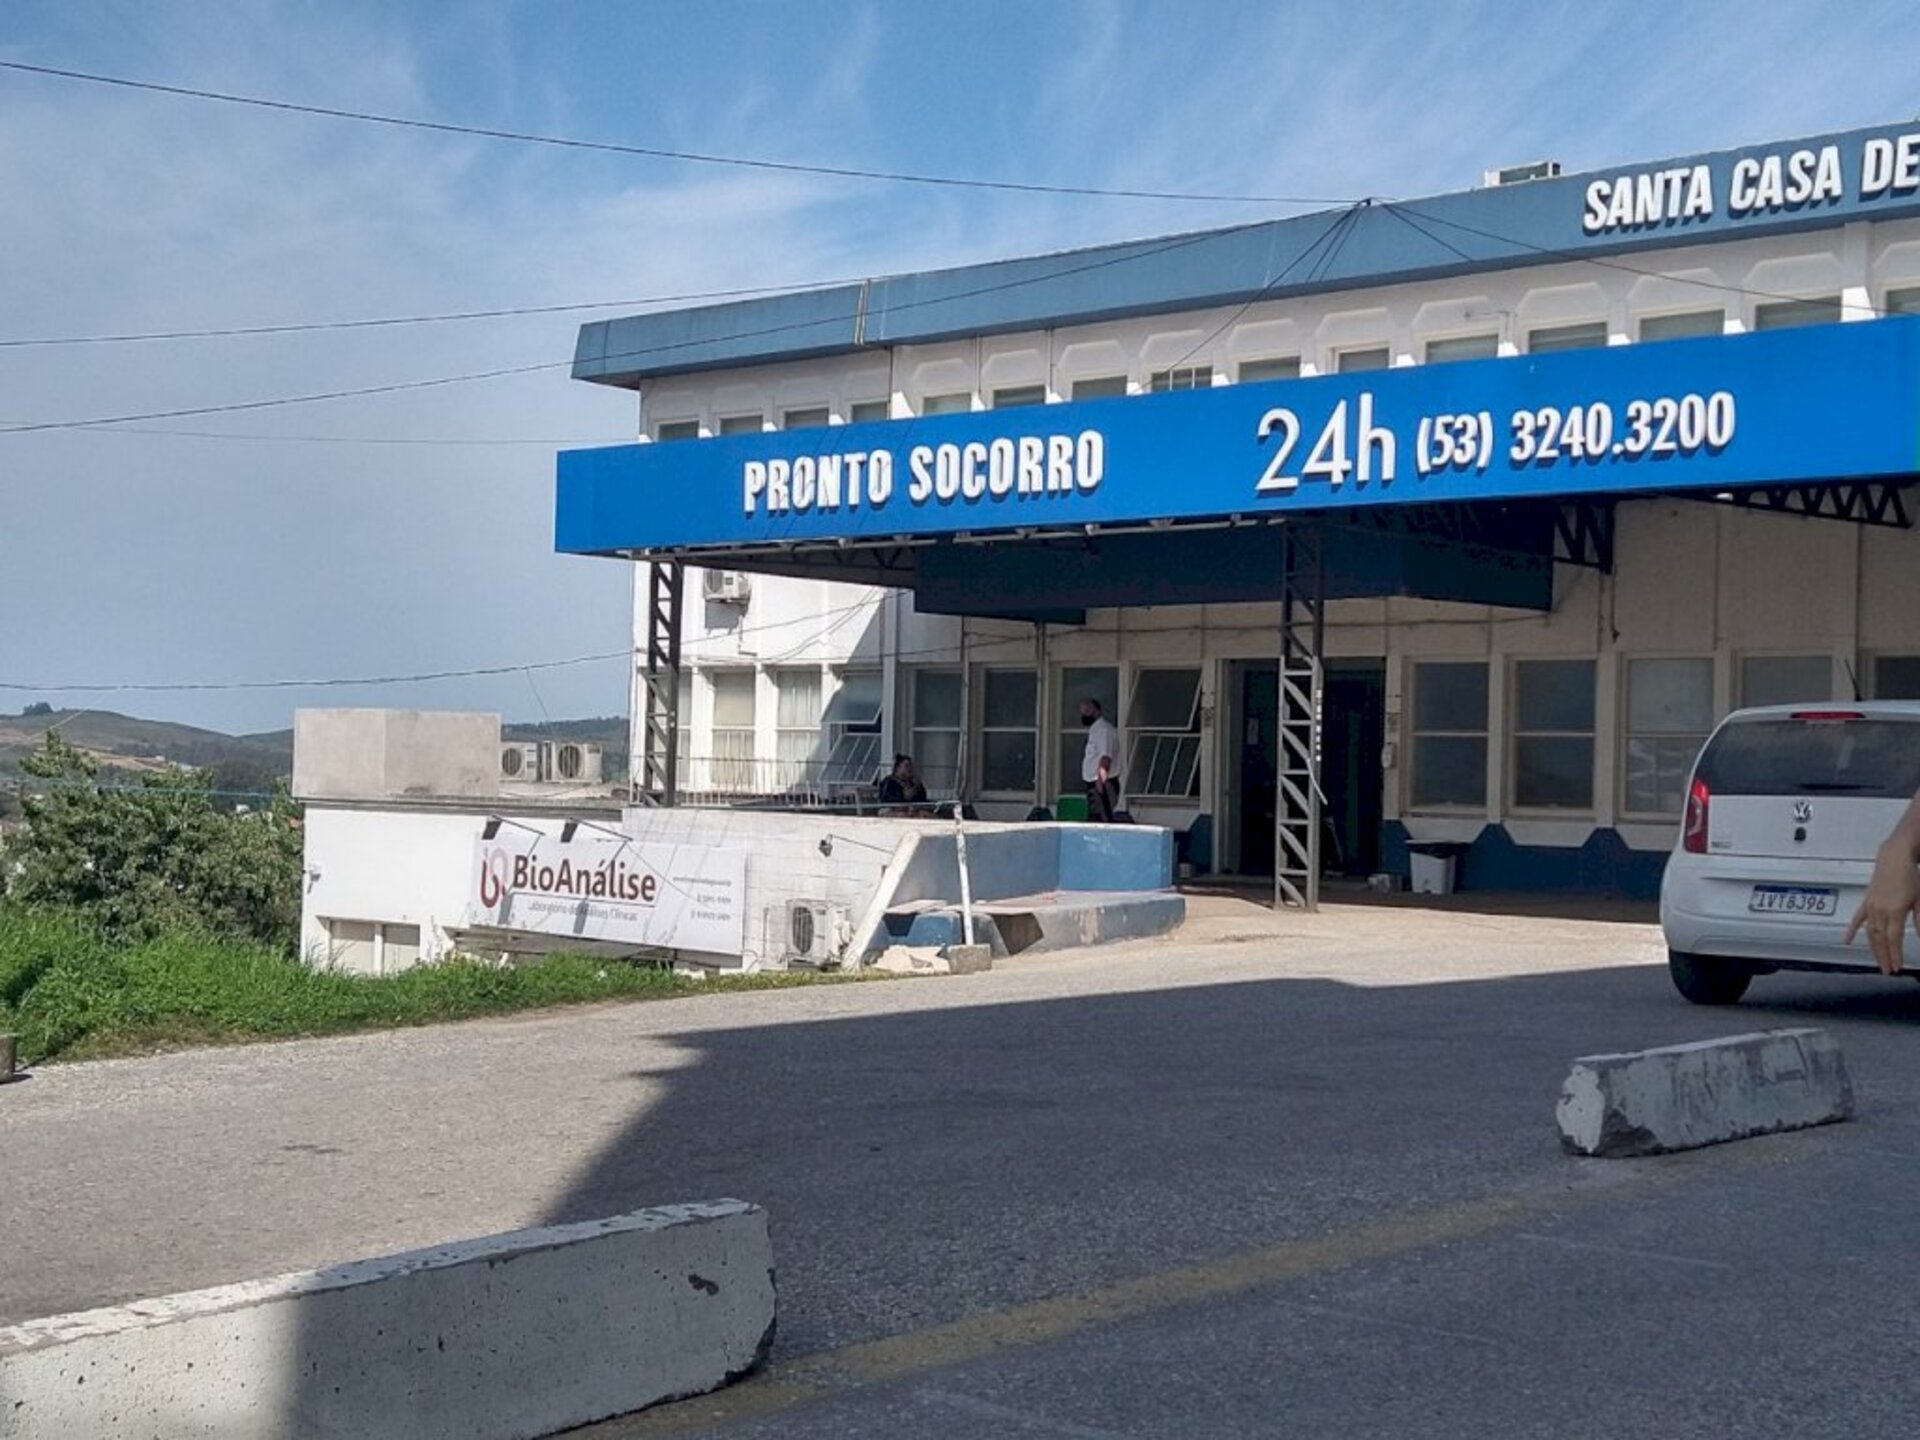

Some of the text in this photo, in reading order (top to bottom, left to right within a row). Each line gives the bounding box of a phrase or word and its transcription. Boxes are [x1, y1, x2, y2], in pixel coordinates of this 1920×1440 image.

[1583, 132, 1920, 231] SANTA CASA DE
[744, 429, 1105, 513] PRONTO SOCORRO
[1255, 391, 1736, 492] 24h (53) 3240.3200
[512, 855, 657, 902] BioAnálise
